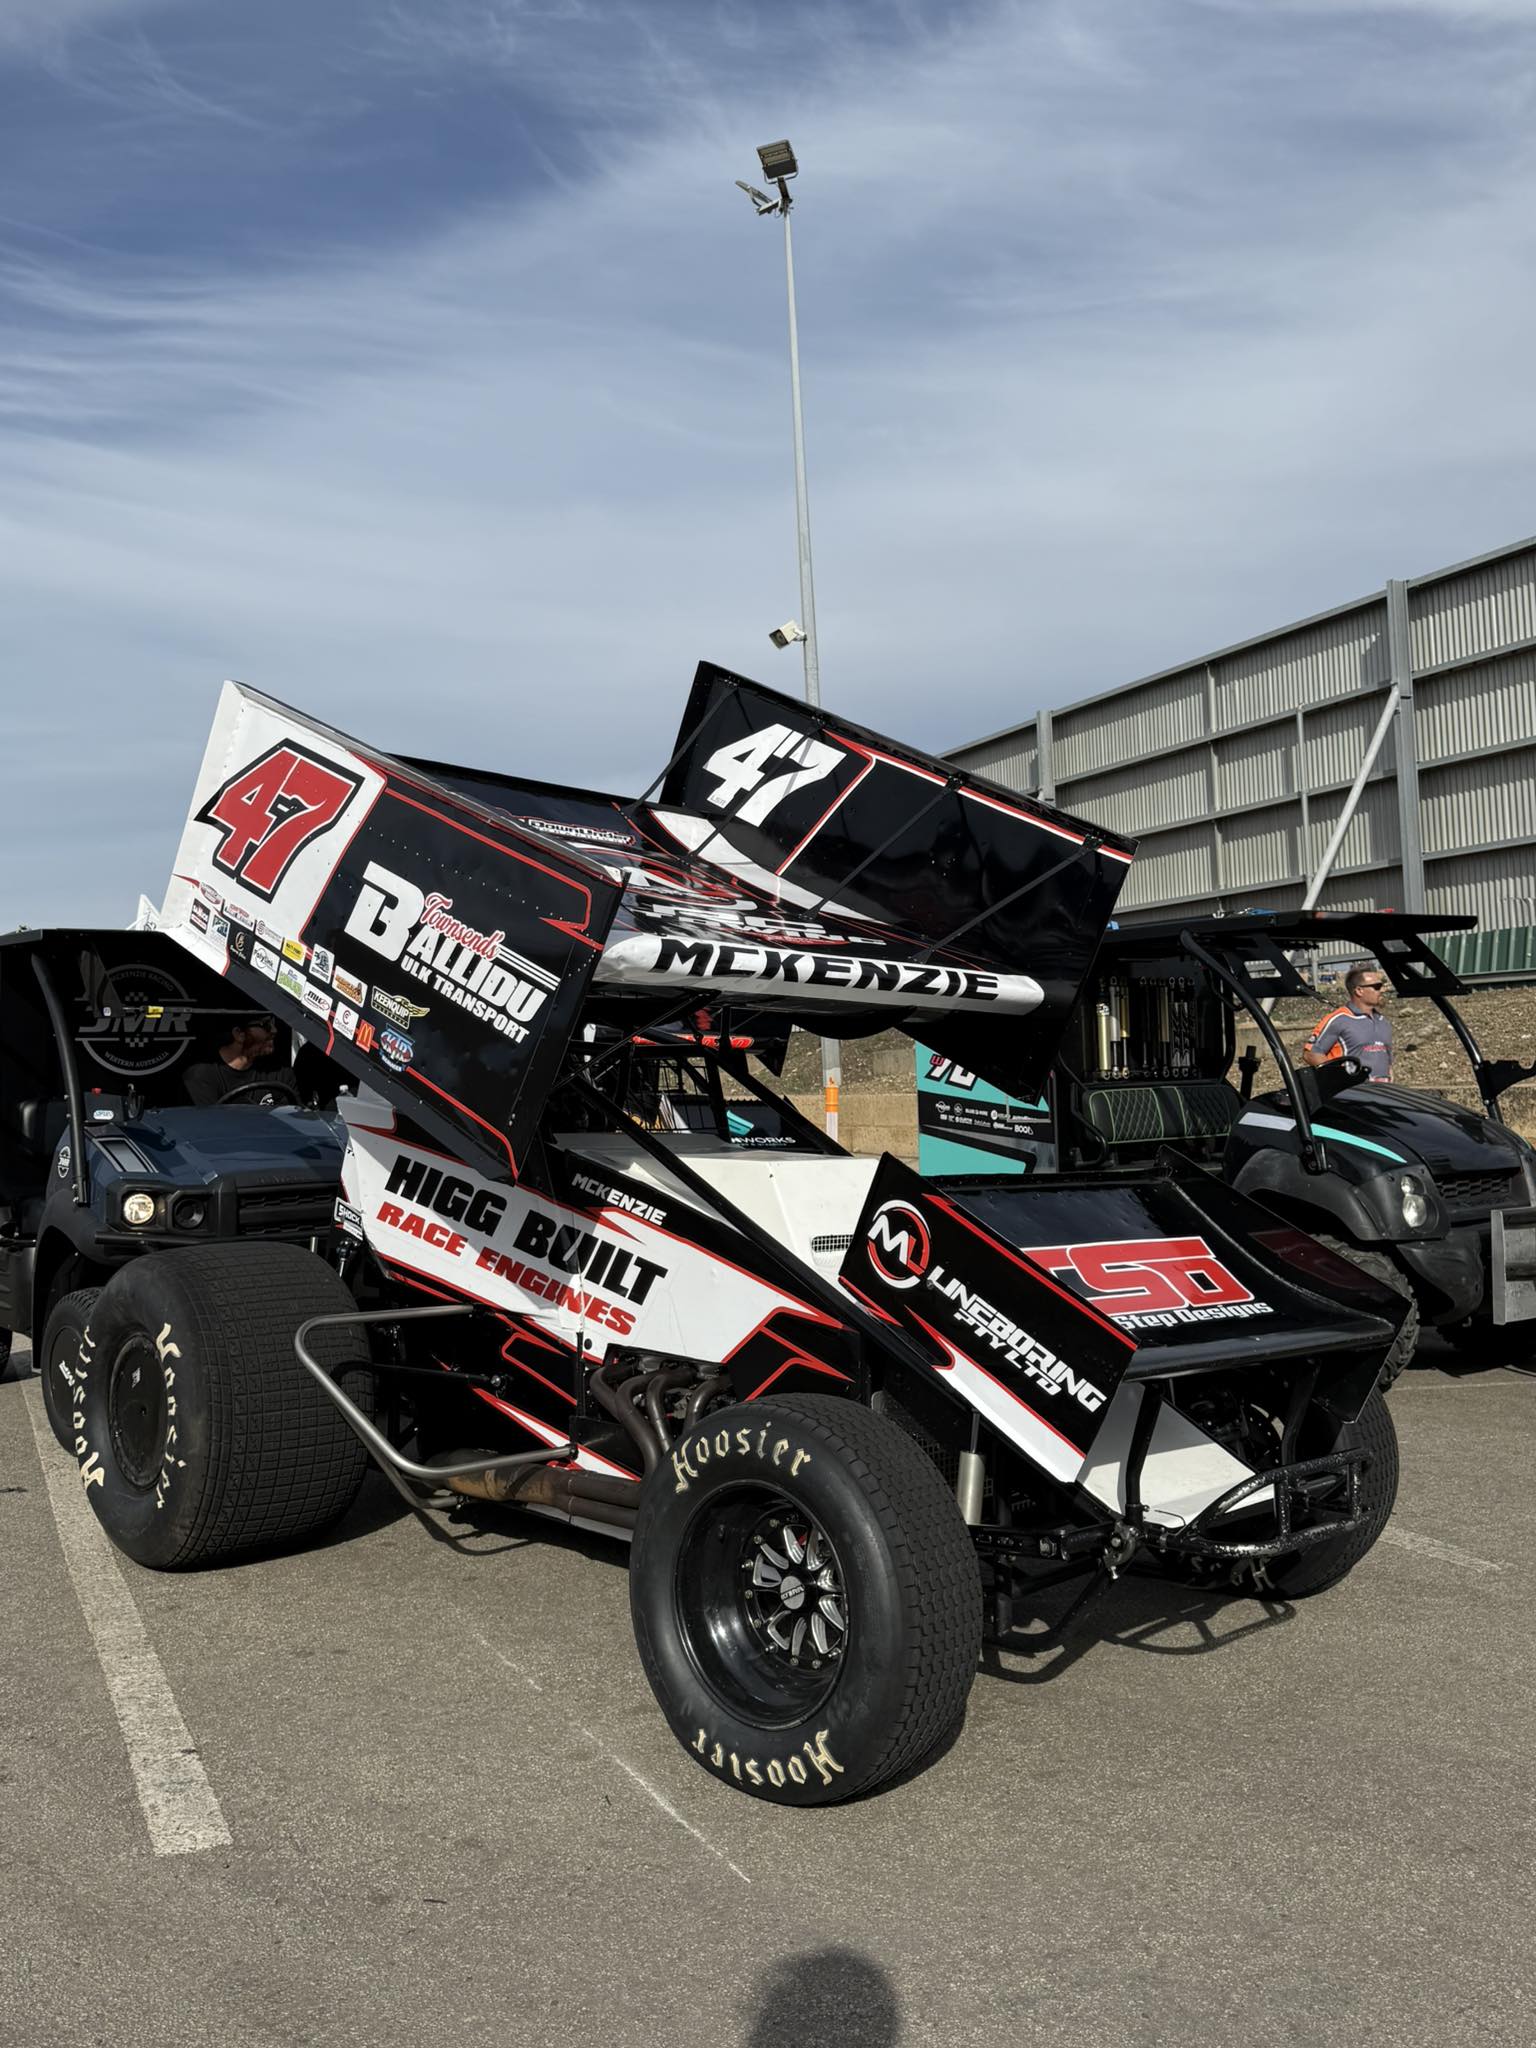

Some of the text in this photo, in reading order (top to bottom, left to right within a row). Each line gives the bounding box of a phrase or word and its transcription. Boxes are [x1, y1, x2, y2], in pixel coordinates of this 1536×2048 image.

[703, 723, 847, 827] 47
[200, 742, 361, 898] 47
[344, 860, 547, 1022] BALLIDU
[420, 892, 505, 961] Townsend's
[373, 991, 409, 1018] KEENQUIP
[650, 938, 999, 1000] MCKENZIE
[433, 975, 530, 1044] TRANSPORT
[104, 1050, 170, 1069] WESTERN AUSTRALIA
[384, 1154, 668, 1306] HIGG BUILT
[571, 1173, 667, 1226] MCKENZIE
[376, 1201, 637, 1336] RACE ENGINES
[954, 1308, 1062, 1396] PTY LTD
[1113, 1302, 1274, 1330] Step Designs
[72, 1325, 105, 1488] Hoosier
[156, 1322, 187, 1509] Hoosier
[672, 1421, 811, 1494] Hoosier
[692, 1729, 844, 1786] Hoosier
